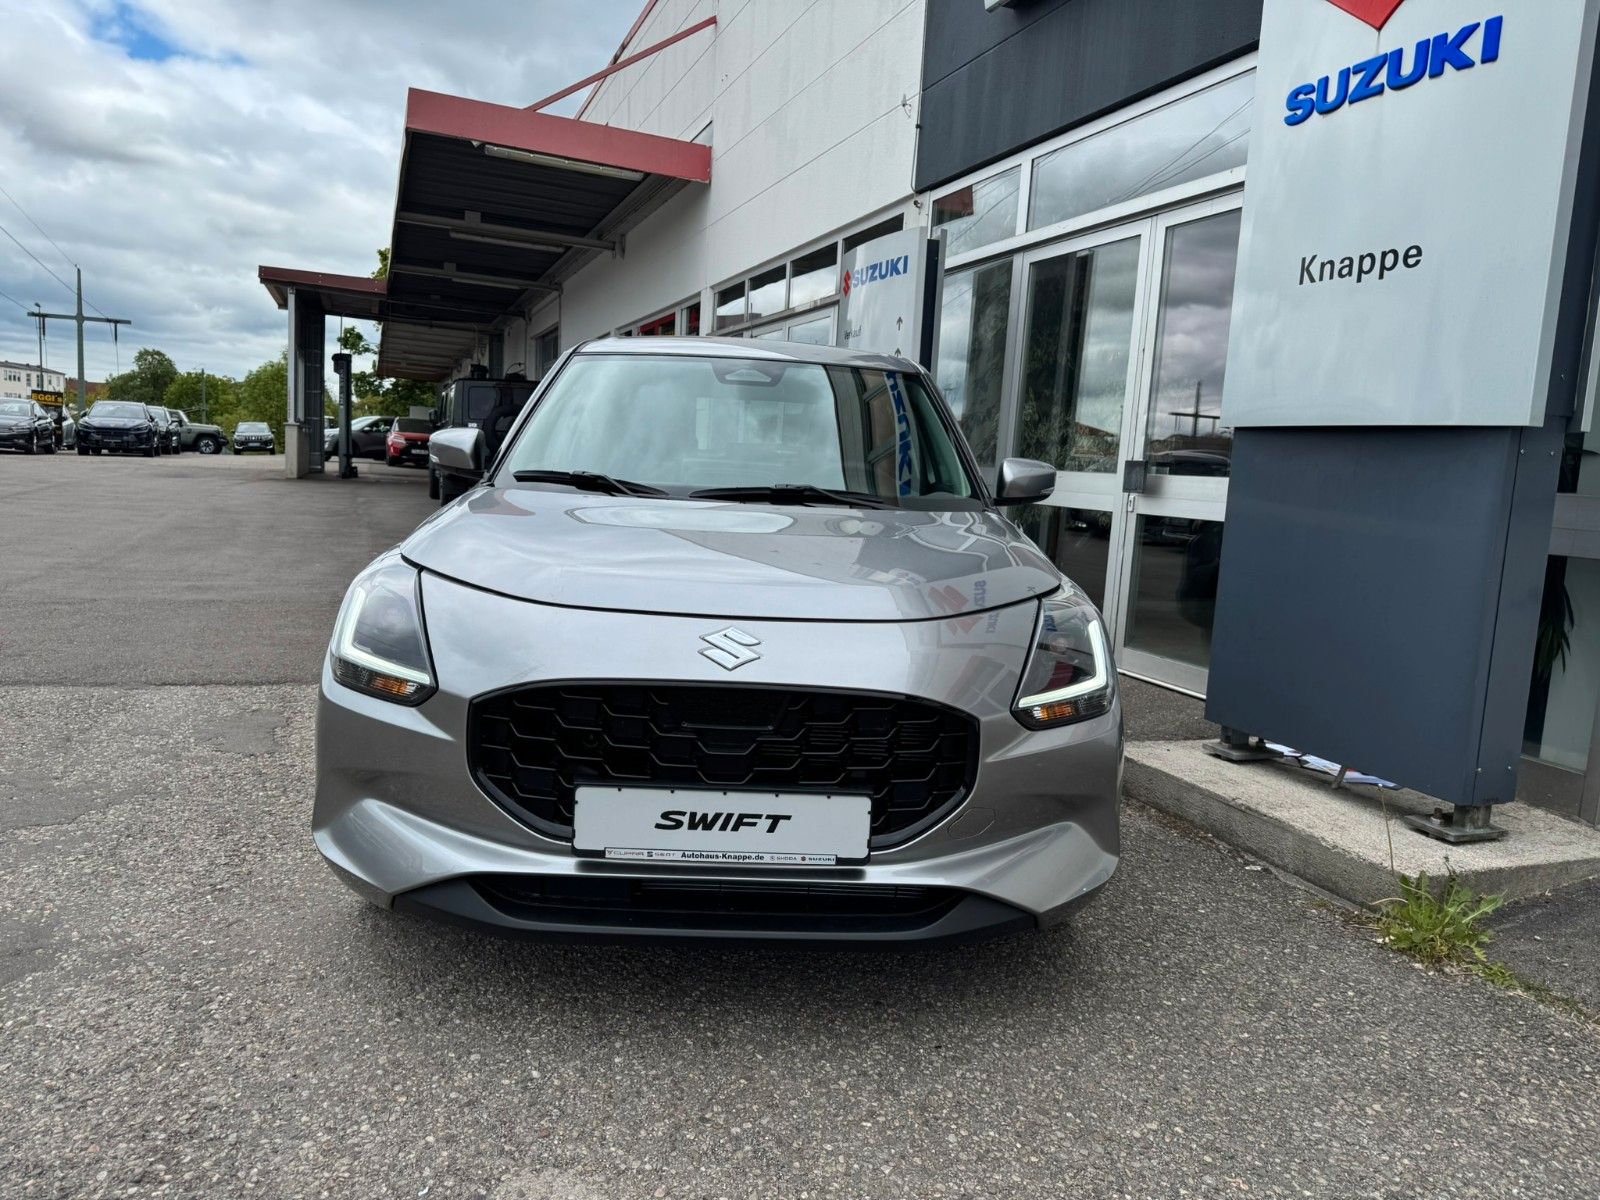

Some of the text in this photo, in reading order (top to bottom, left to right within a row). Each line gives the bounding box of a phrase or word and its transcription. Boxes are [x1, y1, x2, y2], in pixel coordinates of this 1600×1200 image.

[1284, 15, 1503, 127] SUZUKI
[853, 255, 908, 288] SUZUKI
[1299, 244, 1422, 285] Knappe
[654, 810, 792, 833] SWIFT
[680, 851, 765, 862] Autohaus-Knappe.de
